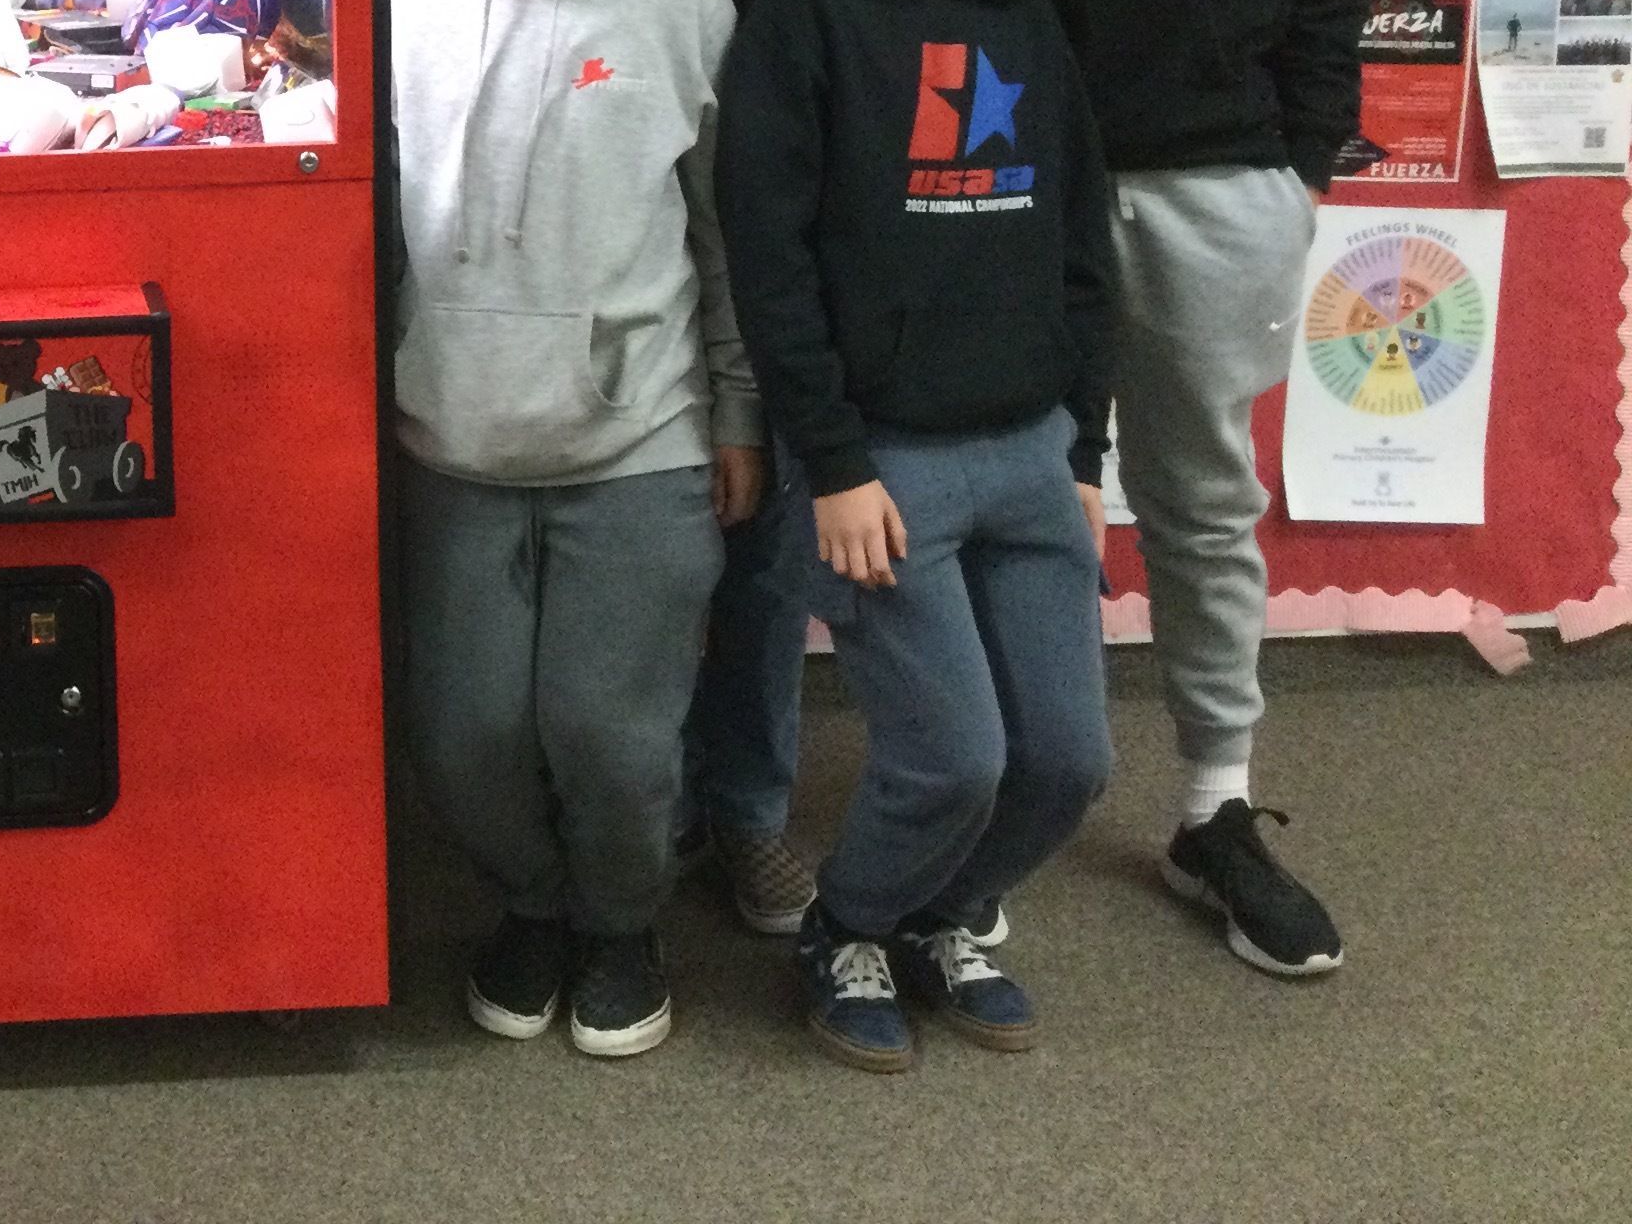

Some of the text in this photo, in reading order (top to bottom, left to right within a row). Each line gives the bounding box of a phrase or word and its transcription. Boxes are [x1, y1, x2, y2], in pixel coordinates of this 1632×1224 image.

[1370, 162, 1446, 177] FUERZA
[905, 199, 928, 212] 2022
[929, 199, 975, 213] NATIONAL
[1345, 222, 1458, 248] FEELINGS WHEEL
